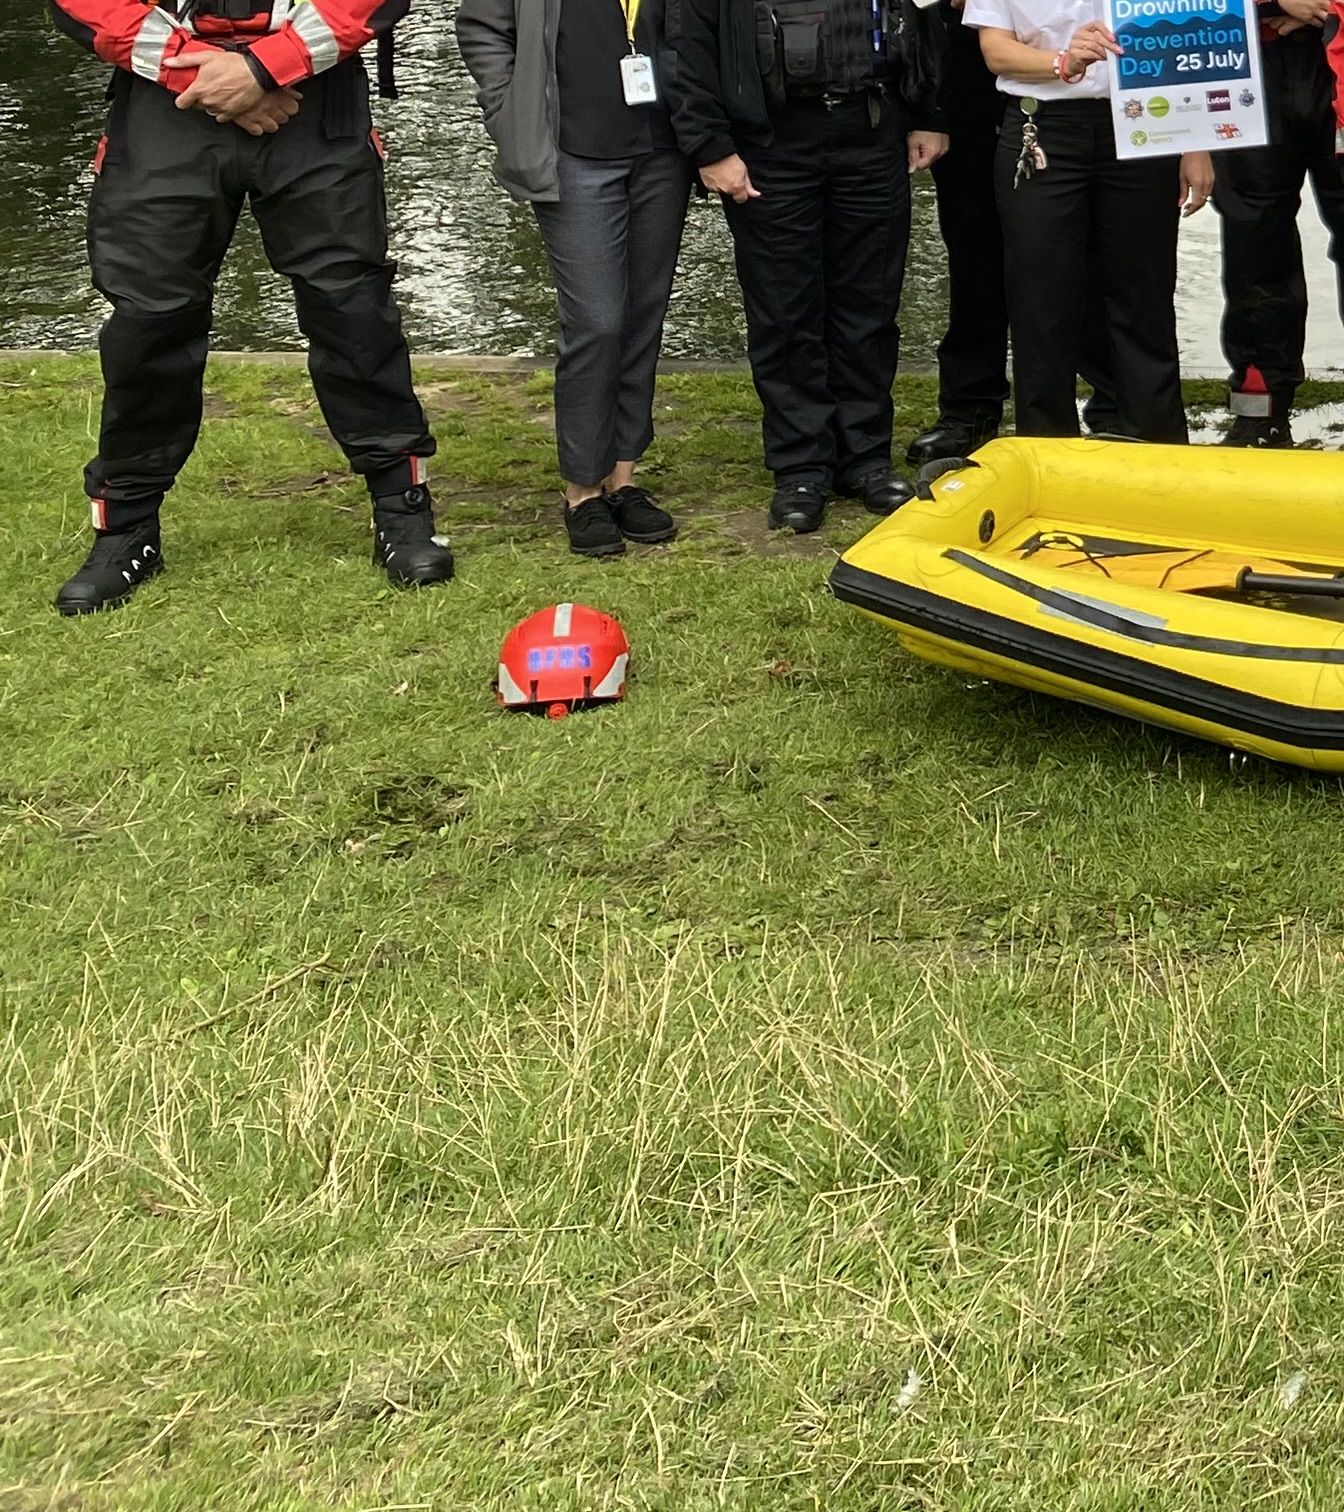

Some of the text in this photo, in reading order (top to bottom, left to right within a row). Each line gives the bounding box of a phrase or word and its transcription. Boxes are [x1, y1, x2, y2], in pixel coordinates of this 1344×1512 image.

[1118, 27, 1243, 51] Prevention
[1120, 50, 1244, 77] Day 25 July
